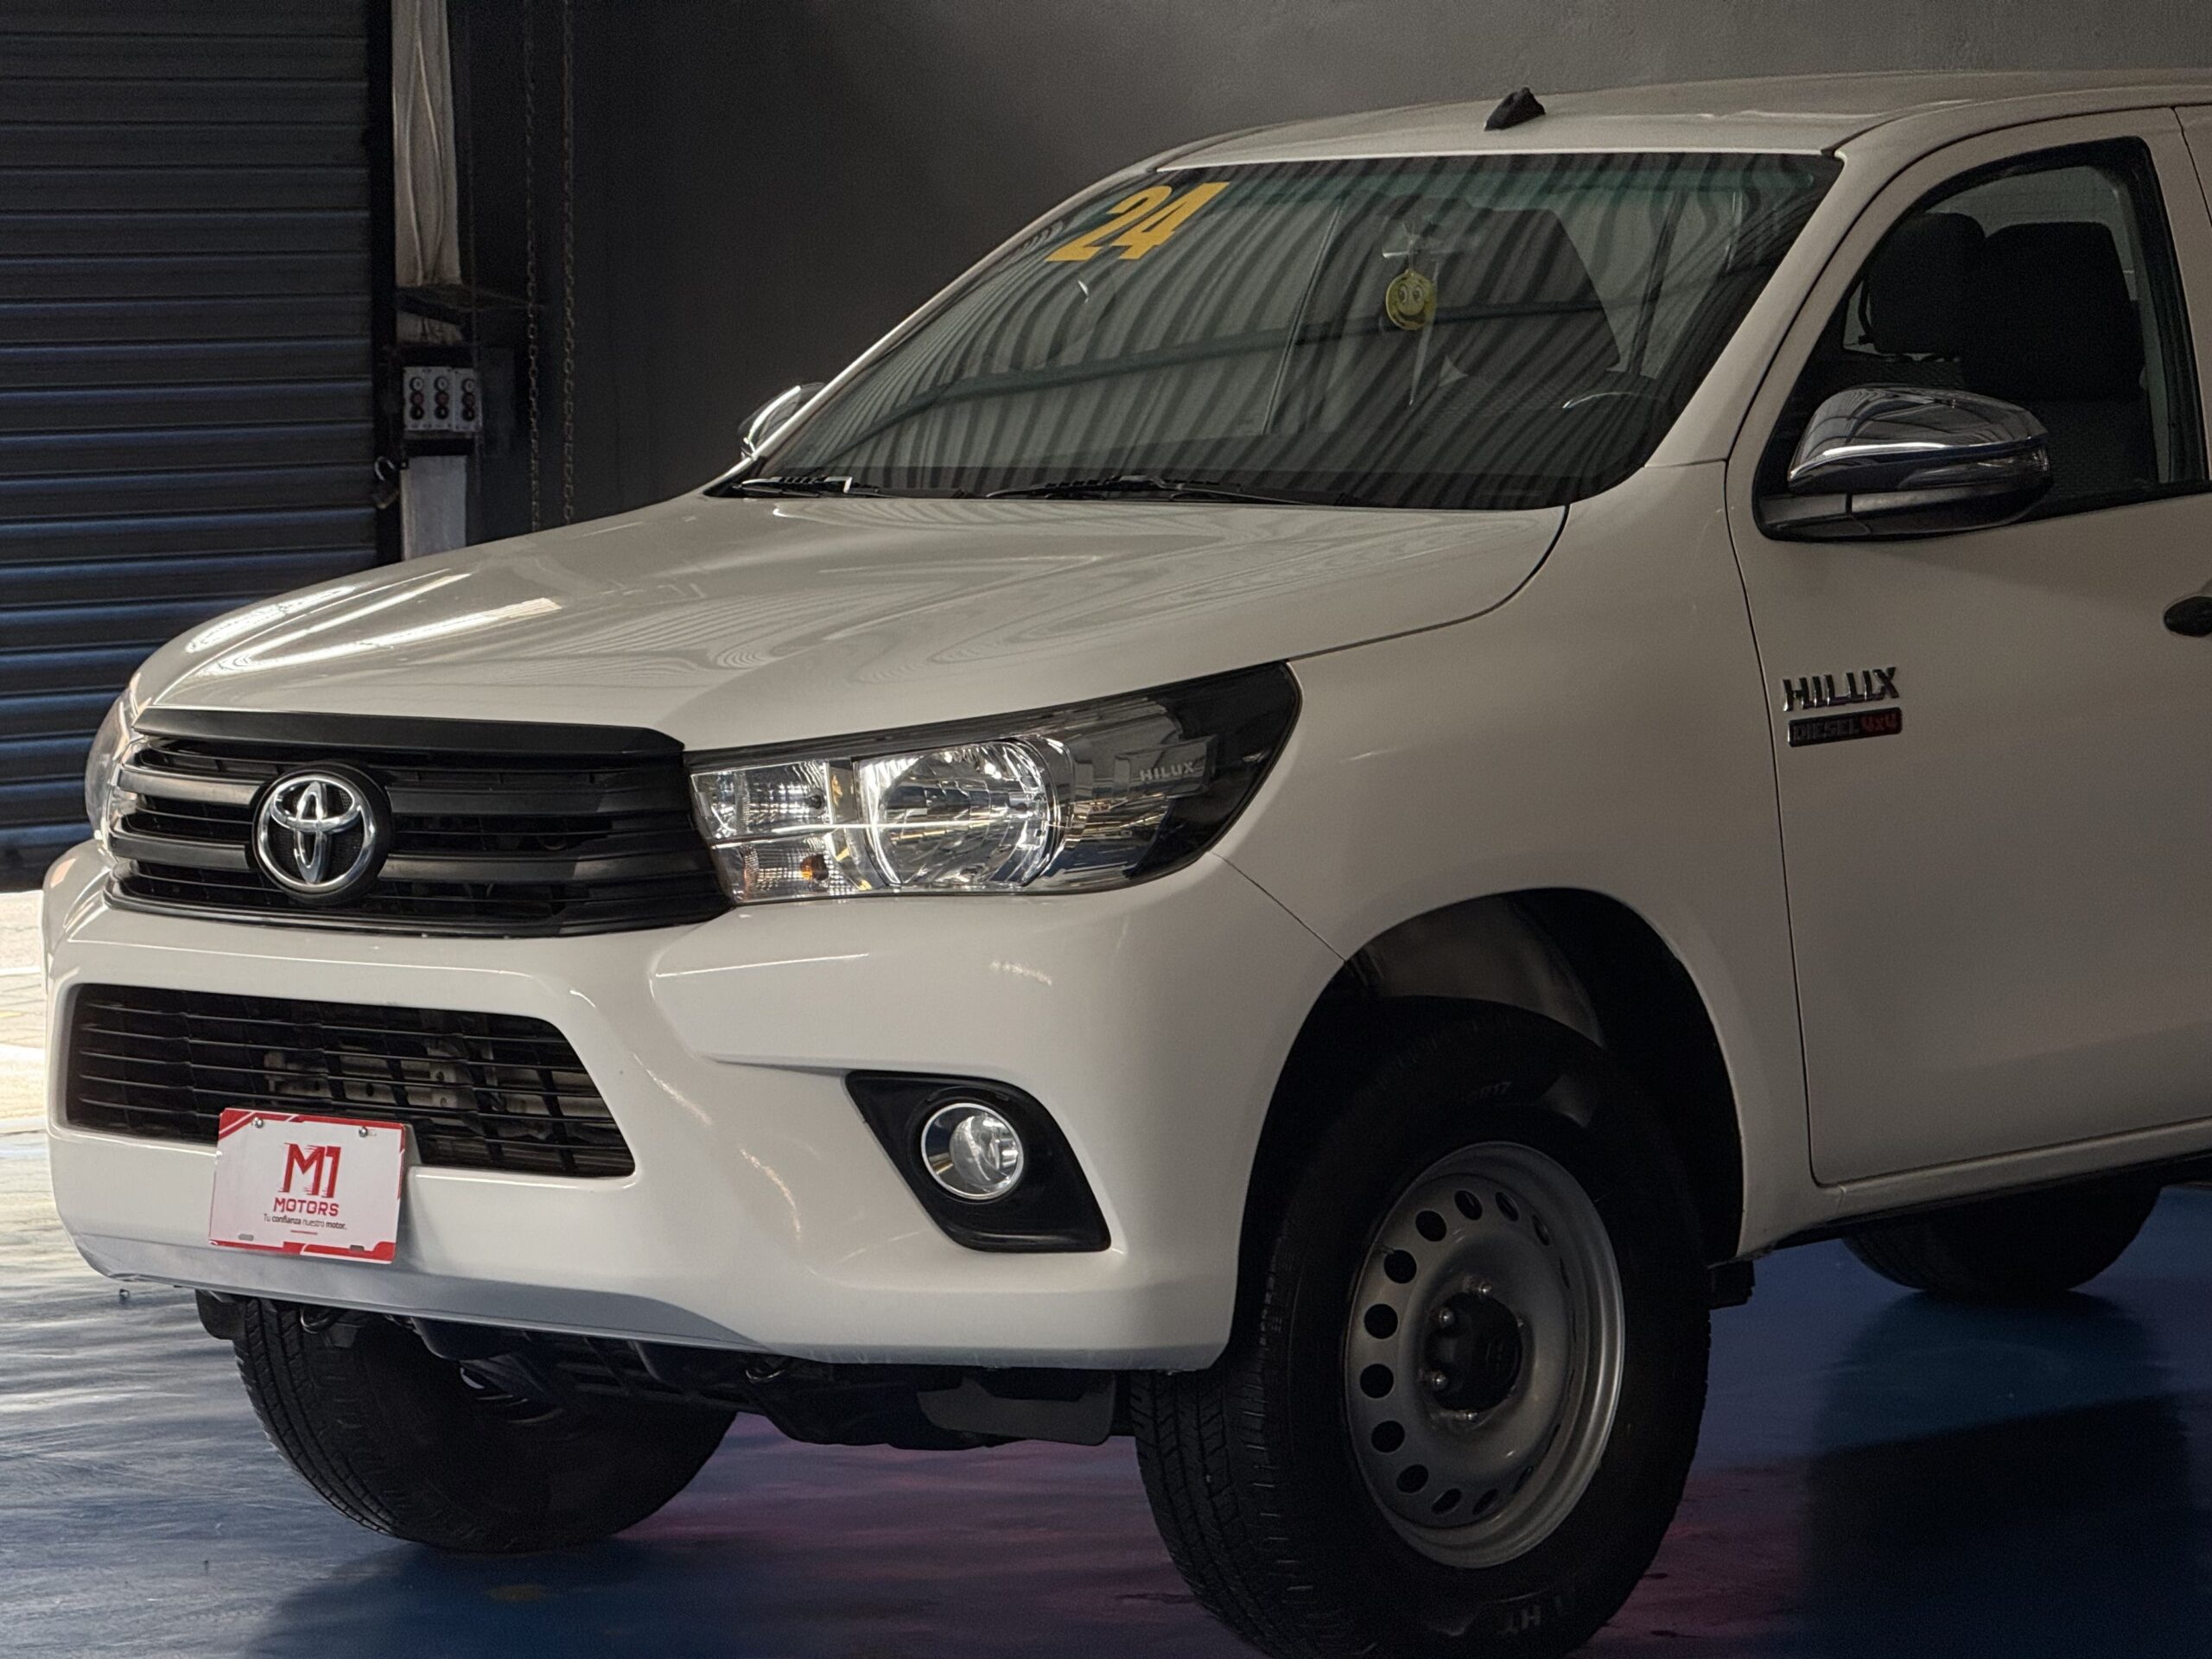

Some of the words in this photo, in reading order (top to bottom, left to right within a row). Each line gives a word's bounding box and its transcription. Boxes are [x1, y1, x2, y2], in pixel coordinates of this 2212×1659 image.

[1044, 181, 1230, 262] 24
[1783, 667, 1900, 712] HILUX
[1792, 717, 1859, 741] DIESEL
[1140, 761, 1194, 782] HILUX
[277, 1142, 342, 1199] M1
[273, 1197, 340, 1217] MOTORS
[264, 1213, 271, 1223] Tu
[271, 1215, 302, 1225] confianza
[302, 1218, 325, 1228] nuestro
